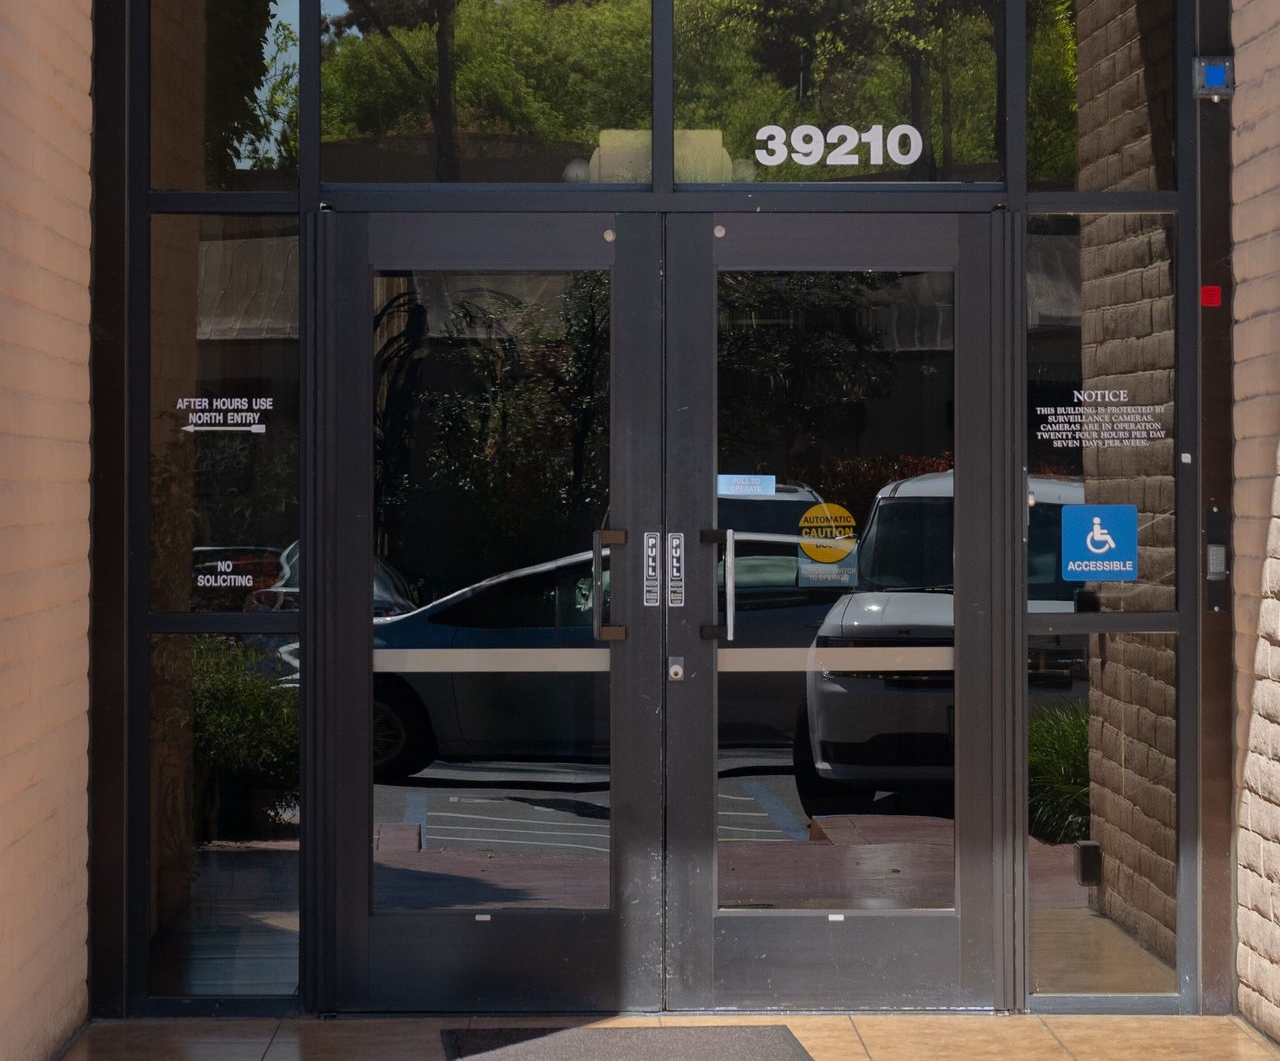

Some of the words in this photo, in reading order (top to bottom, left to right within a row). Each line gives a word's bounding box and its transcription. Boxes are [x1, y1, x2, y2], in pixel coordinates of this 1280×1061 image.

[754, 124, 924, 167] 39210
[1072, 390, 1129, 403] NOTICE
[176, 398, 209, 410] AFTER
[213, 398, 249, 410] HOURS
[252, 398, 274, 410] USE
[1035, 407, 1055, 415] THIS
[1056, 407, 1096, 415] BUILDING
[1097, 406, 1105, 414] IS
[1107, 406, 1153, 414] PROTECTED
[1155, 405, 1165, 414] BY
[188, 412, 224, 424] NORTH
[227, 412, 261, 424] ENTRY
[1047, 415, 1111, 423] SURVEILLANCE
[1040, 423, 1081, 431] CAMERAS
[1082, 423, 1100, 431] ARE
[1113, 422, 1162, 430] OPERATION
[1036, 432, 1098, 440] TWENTY-FOUR
[1100, 431, 1130, 439] HOURS
[1149, 430, 1166, 438] DAY
[1052, 440, 1080, 448] SEVEN
[1082, 440, 1103, 448] DAYS
[803, 515, 852, 524] AUTOMATIC
[802, 527, 854, 538] CAUTION
[648, 538, 656, 576] PULL
[672, 538, 680, 576] PULL
[217, 561, 233, 572] NO
[1067, 561, 1134, 571] ACCESSIBLE
[197, 575, 254, 587] SOLICITING
